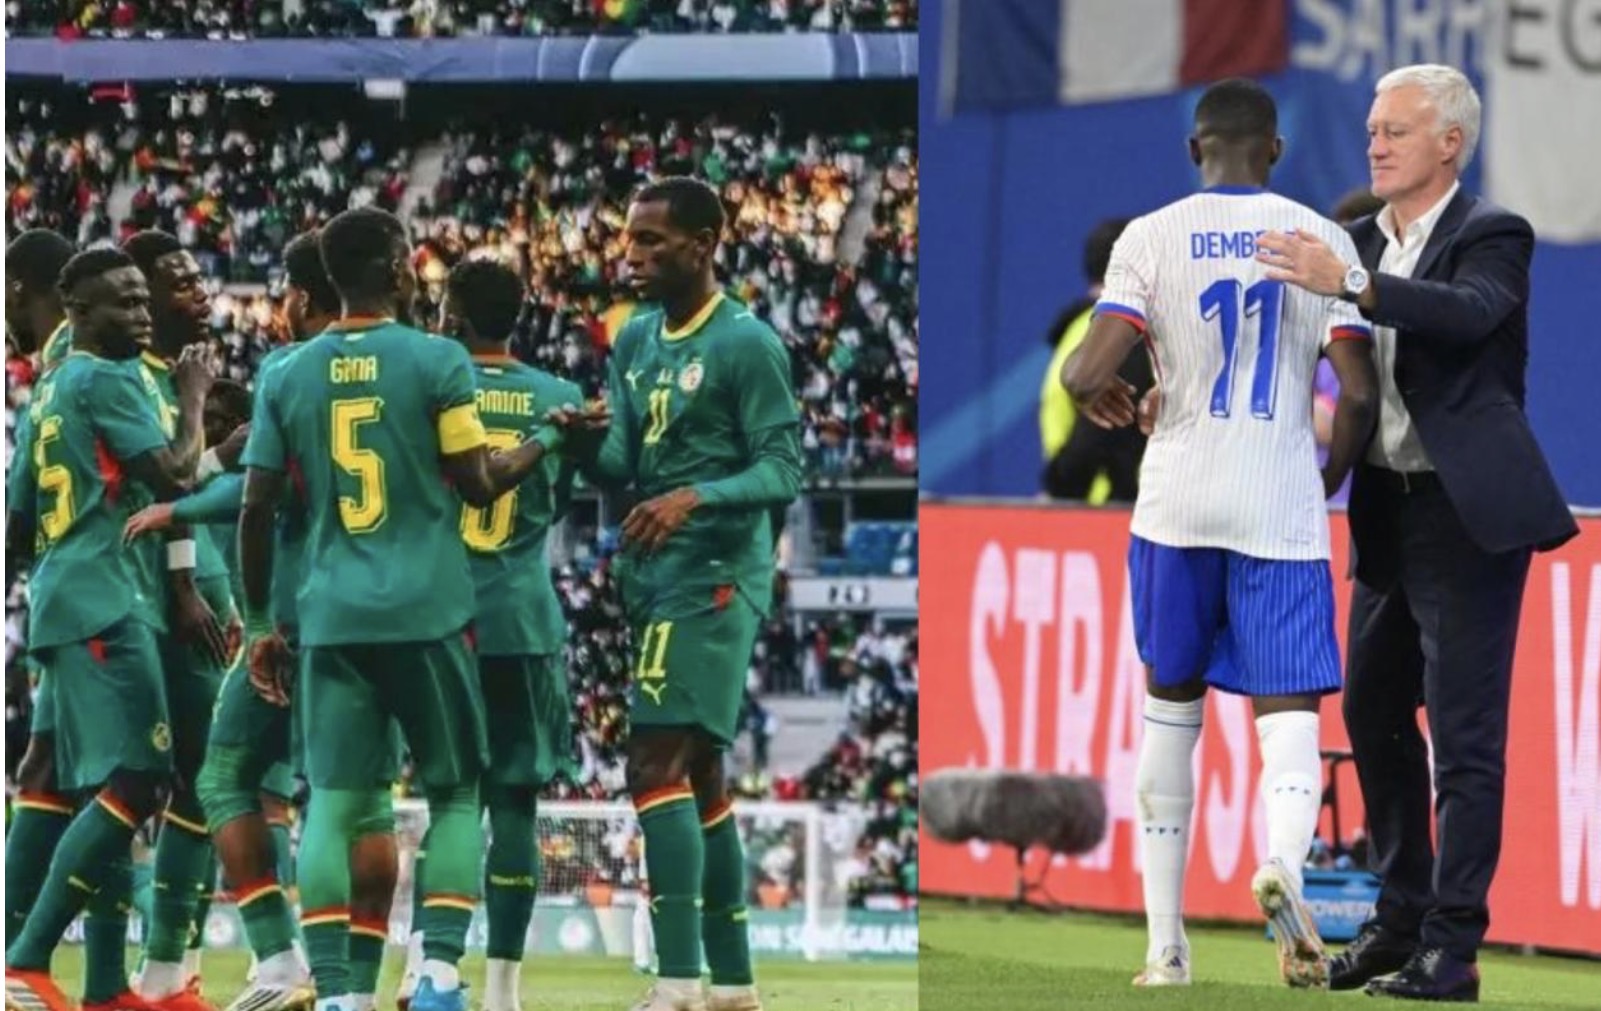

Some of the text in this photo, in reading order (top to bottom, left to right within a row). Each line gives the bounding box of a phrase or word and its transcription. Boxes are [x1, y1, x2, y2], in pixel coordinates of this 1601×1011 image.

[1191, 230, 1293, 259] DEMB
[330, 356, 377, 384] GANA
[1199, 278, 1286, 420] 11
[475, 388, 535, 416] AMINE
[643, 387, 671, 445] 11
[332, 397, 388, 534] 5
[637, 621, 674, 679] 11
